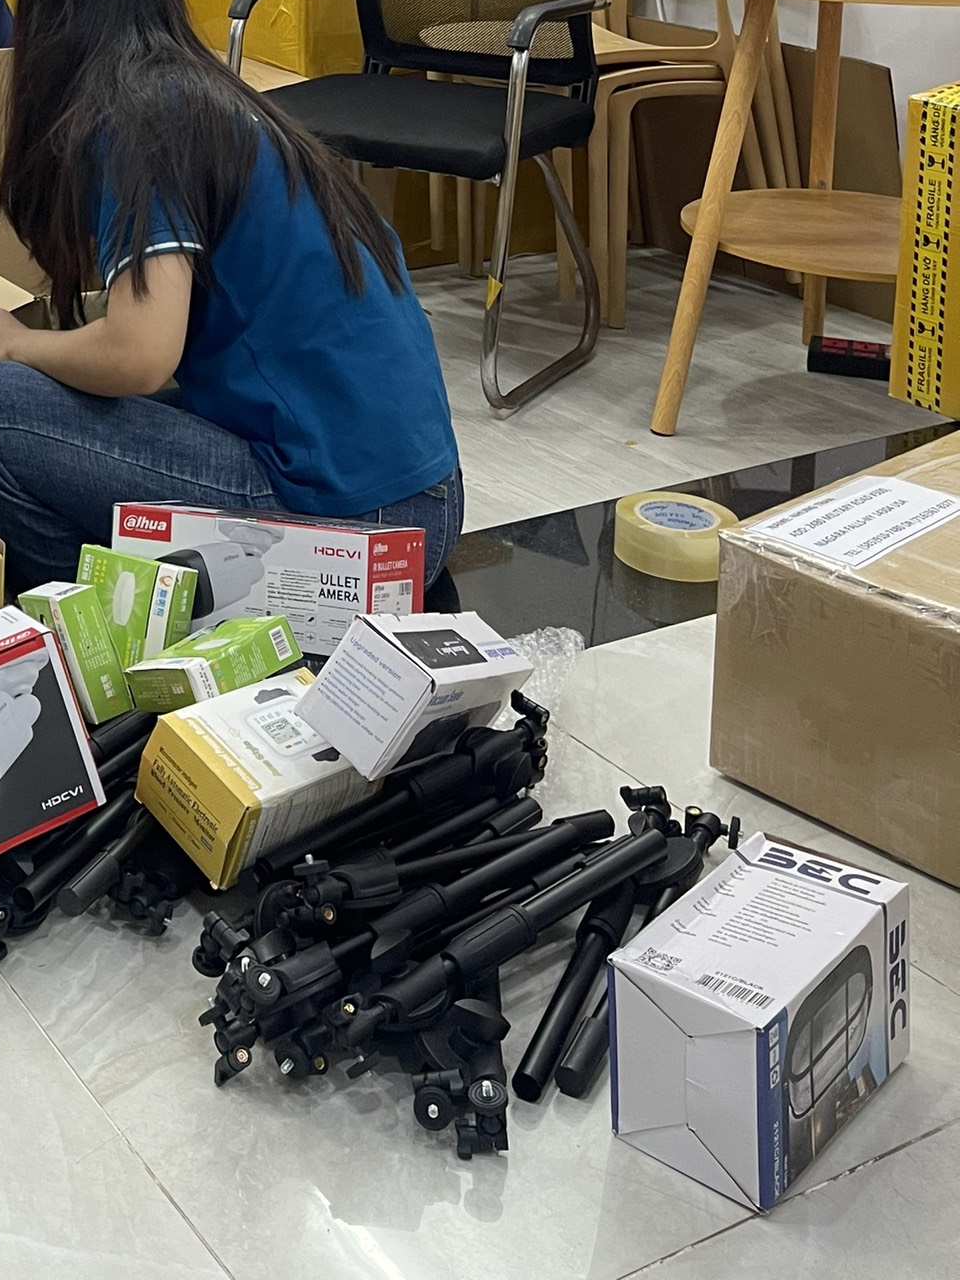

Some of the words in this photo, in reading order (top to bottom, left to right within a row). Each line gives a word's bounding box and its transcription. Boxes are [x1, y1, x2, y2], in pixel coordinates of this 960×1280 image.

[926, 179, 936, 228] FRAGILE
[917, 345, 927, 393] FRAGILE
[314, 545, 361, 560] HDCVI
[320, 573, 360, 589] ULLET
[318, 590, 360, 603] AMERA
[350, 636, 380, 663] Upgraded
[378, 659, 402, 681] version
[41, 785, 84, 811] HDCVI
[152, 758, 166, 778] Fully
[165, 772, 192, 805] Automatic
[191, 800, 219, 833] Electronic
[715, 970, 764, 991] 2121C/BLACK
